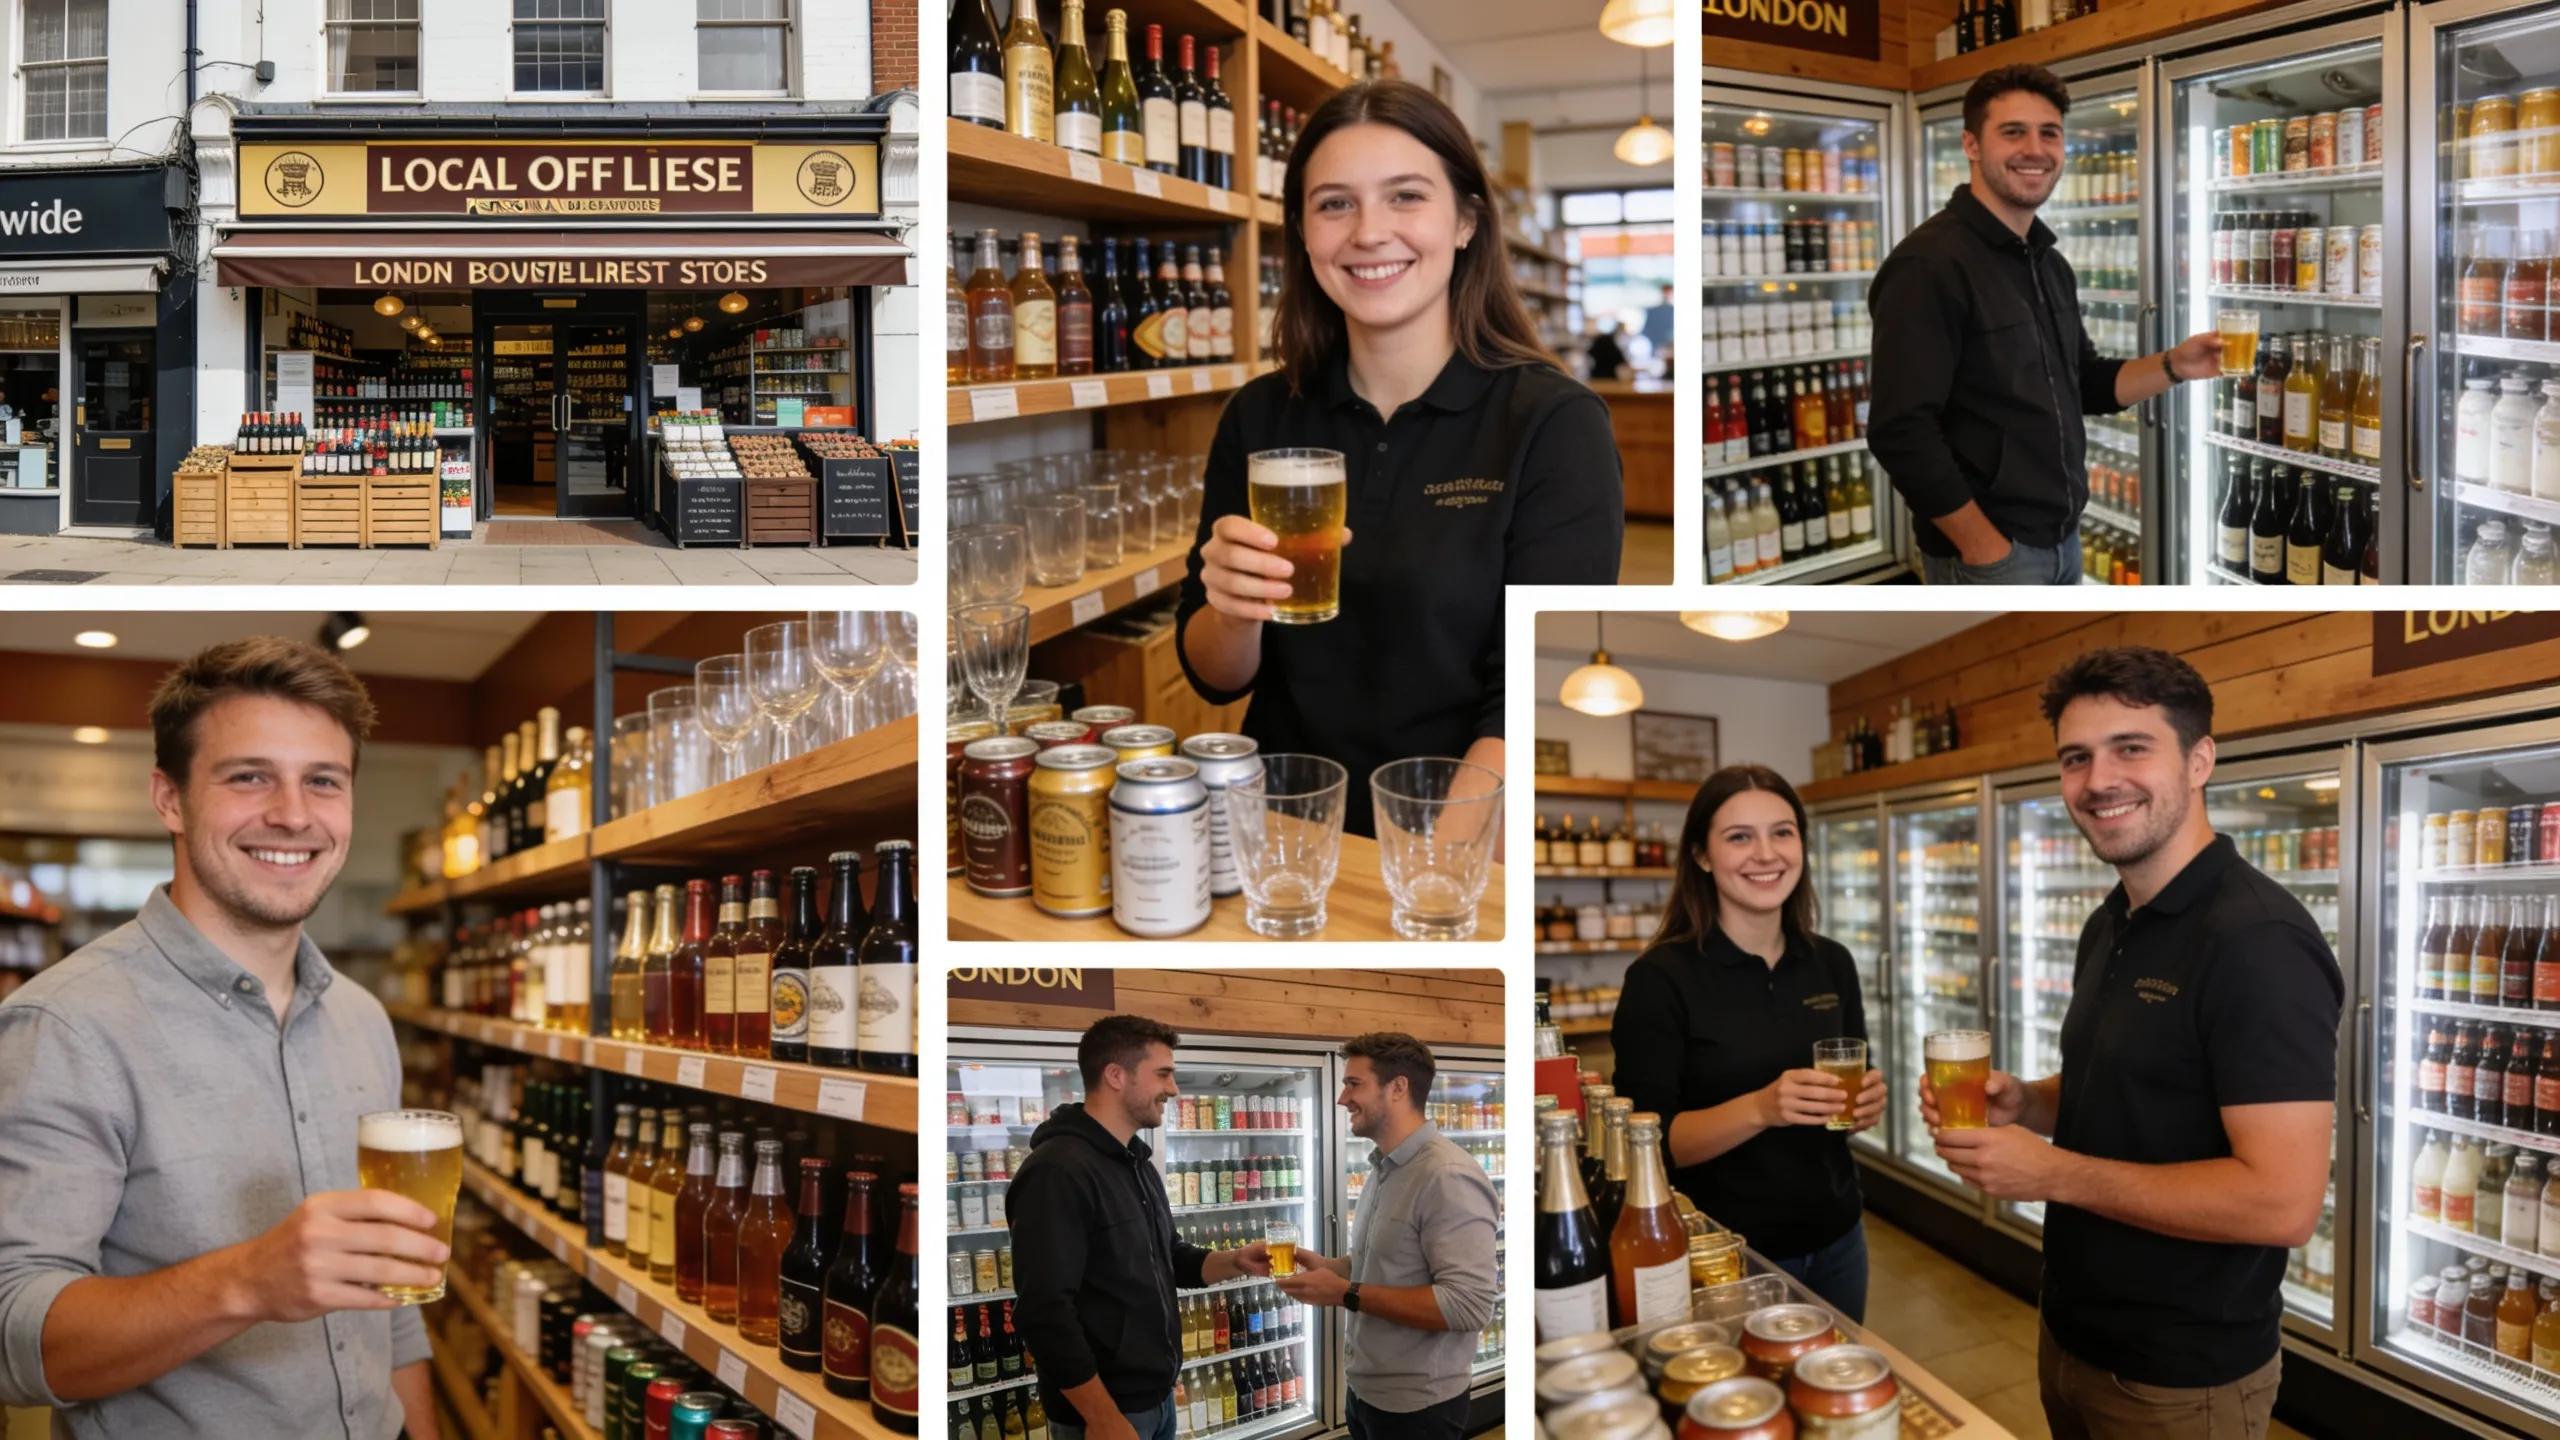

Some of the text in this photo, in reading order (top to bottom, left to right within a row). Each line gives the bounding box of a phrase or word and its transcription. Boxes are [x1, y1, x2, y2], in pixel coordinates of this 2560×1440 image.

[381, 155, 743, 193] LOCAL OFF LIESE
[0, 198, 83, 236] wide
[355, 261, 452, 285] LONDN
[680, 260, 768, 285] STOES
[2404, 610, 2538, 644] LON
[947, 967, 1083, 991] ONDON
